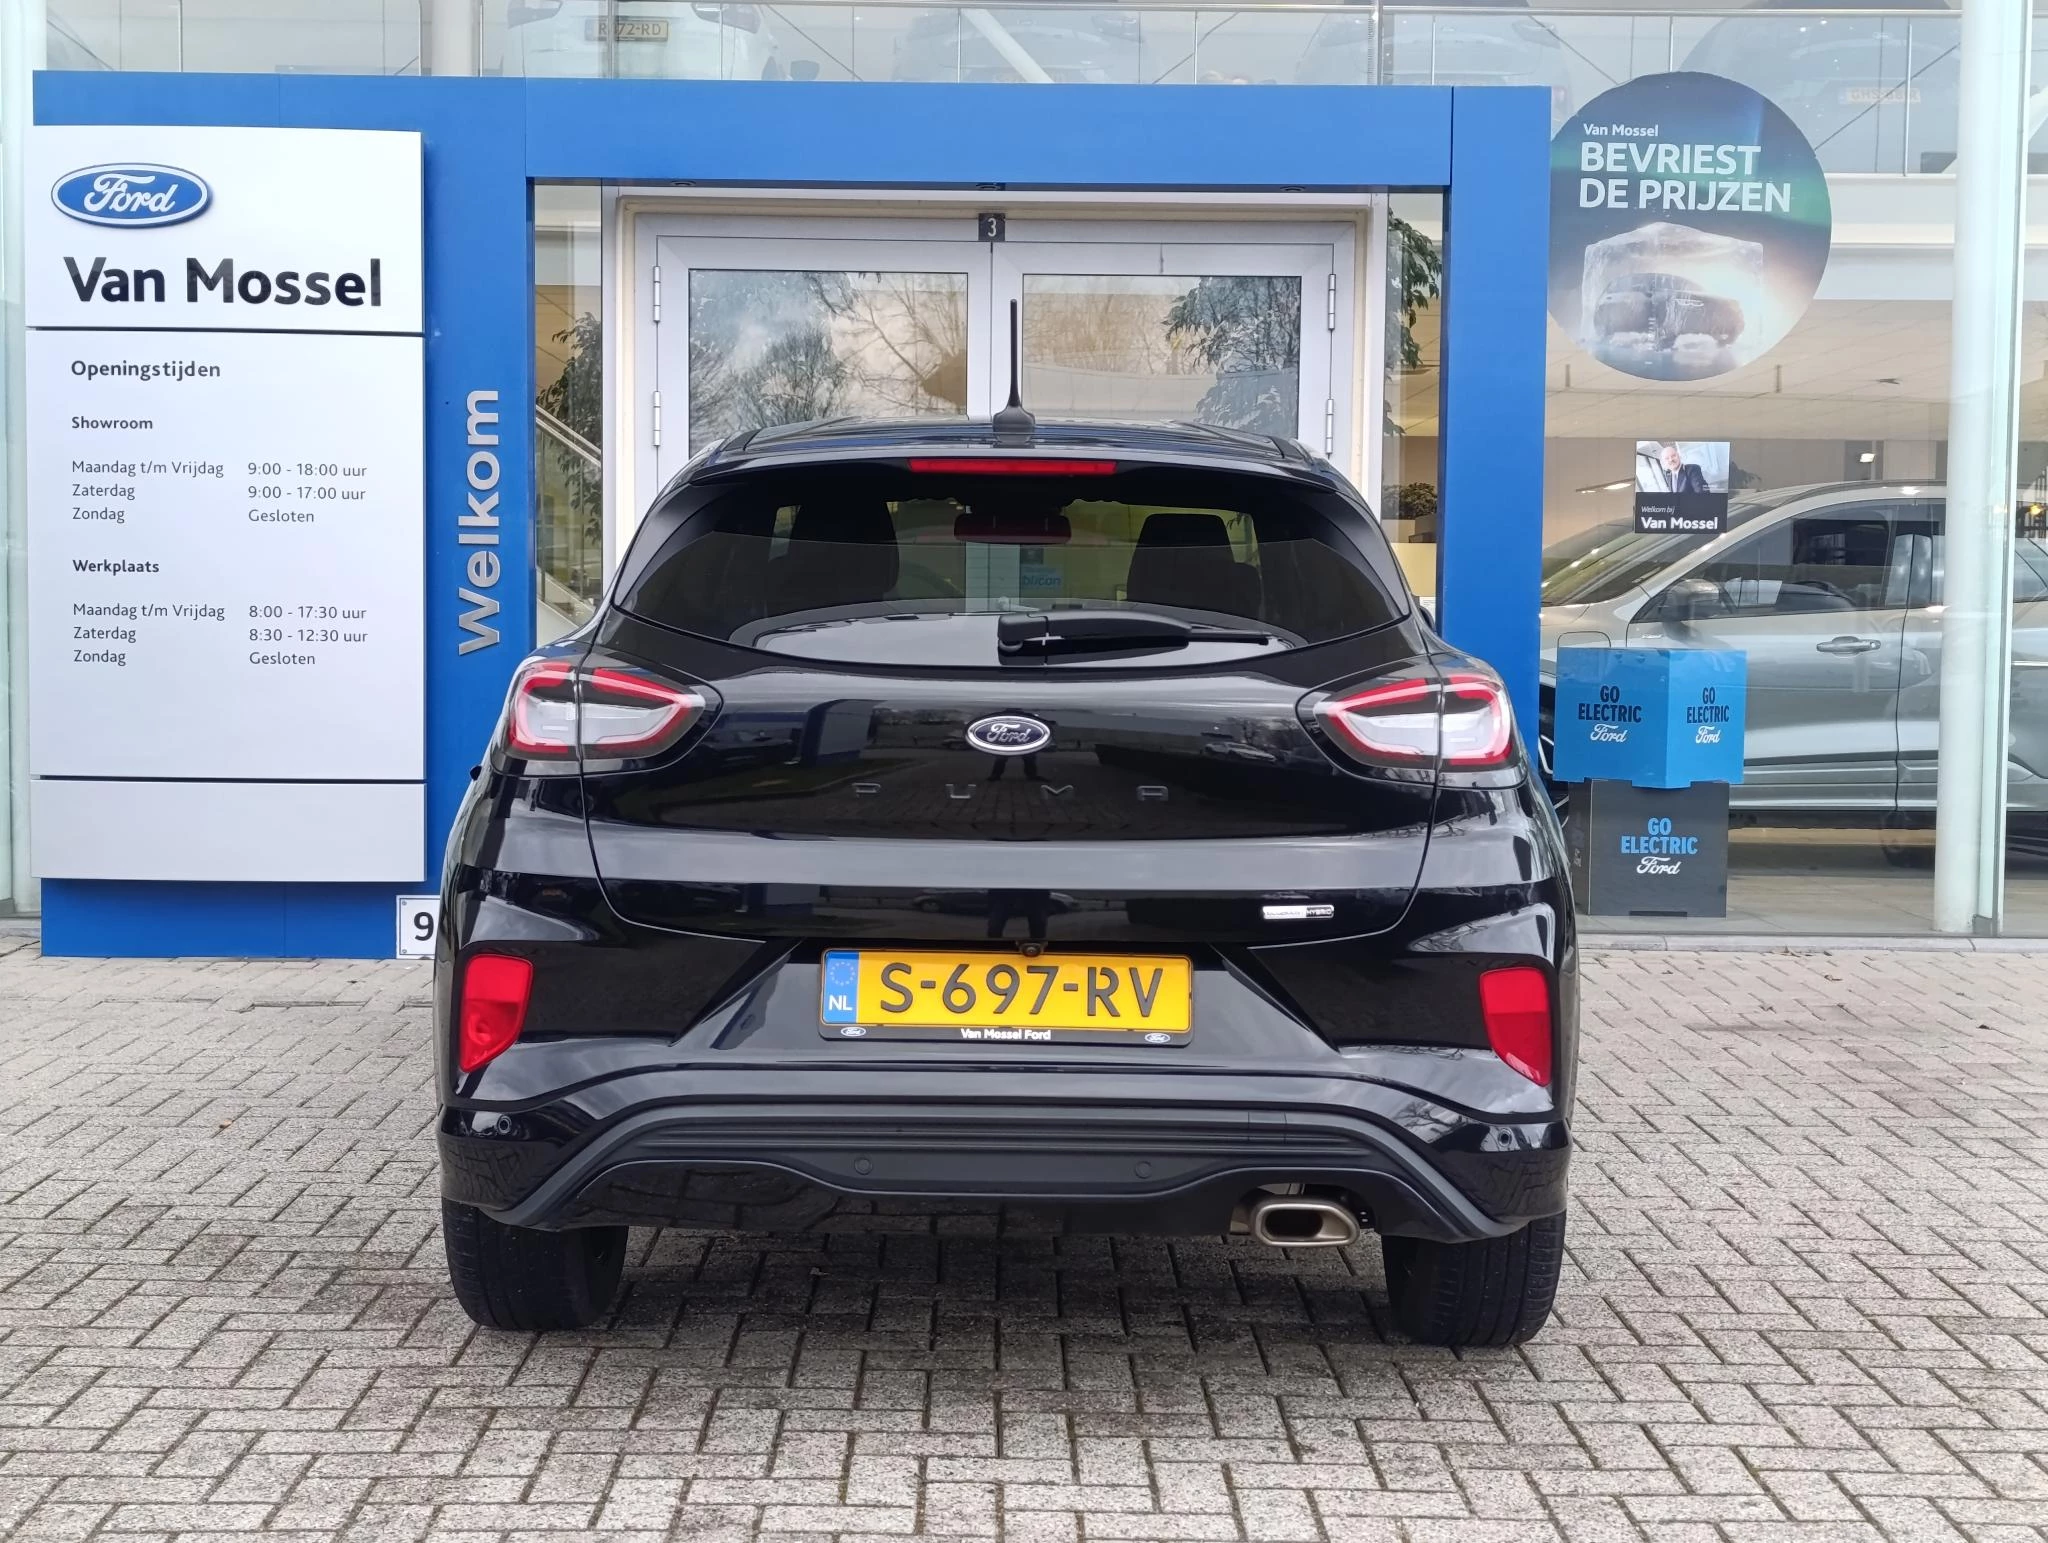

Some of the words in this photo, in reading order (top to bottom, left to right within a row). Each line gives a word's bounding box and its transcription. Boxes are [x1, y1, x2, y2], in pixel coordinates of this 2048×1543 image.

[1583, 123, 1608, 136] Van
[1612, 124, 1659, 136] Mossel
[1580, 141, 1761, 175] BEVRIEST
[83, 174, 178, 214] Ford
[1579, 178, 1629, 208] DE
[1638, 180, 1791, 212] PRIJZEN
[988, 218, 996, 236] 3
[63, 256, 166, 303] Van
[186, 257, 382, 307] Mossel
[71, 360, 221, 381] Openingstijden
[71, 415, 153, 430] Showroom
[71, 460, 136, 478] Maandag
[140, 460, 168, 475] t/m
[171, 460, 225, 478] Vrijdag
[247, 462, 282, 477] 9:00
[296, 462, 338, 478] 18:00
[342, 465, 368, 478] uur
[71, 483, 136, 501] Zaterdag
[247, 485, 282, 500] 9:00
[296, 485, 337, 501] 17:00
[341, 488, 367, 501] uur
[71, 506, 126, 524] Zondag
[248, 508, 315, 524] Gesloten
[458, 390, 500, 656] Welkom
[1641, 516, 1666, 529] Van
[1670, 516, 1718, 530] Mossel
[72, 559, 160, 576] Werkplaats
[72, 603, 137, 621] Maandag
[141, 603, 168, 618] t/m
[172, 603, 226, 621] Vrijdag
[248, 605, 283, 619] 8:00
[298, 605, 338, 620] 17:30
[342, 607, 367, 620] uur
[72, 626, 137, 643] Zaterdag
[248, 628, 283, 643] 8:30
[298, 628, 339, 643] 12:30
[343, 631, 368, 643] uur
[73, 649, 127, 667] Zondag
[249, 651, 316, 666] Gesloten
[1600, 686, 1620, 703] GO
[1702, 687, 1716, 704] GO
[1578, 703, 1642, 723] ELECTRIC
[1686, 705, 1730, 724] ELECTRIC
[986, 723, 1031, 742] Ford
[1590, 724, 1628, 743] Ford
[1696, 726, 1720, 744] Ford
[1648, 817, 1672, 836] GO
[1621, 836, 1698, 854] ELECTRIC
[1636, 856, 1682, 875] Ford
[414, 912, 434, 942] 9
[828, 995, 852, 1010] NL
[880, 962, 1163, 1017] S-697-RV
[960, 1028, 981, 1038] Van
[984, 1029, 1022, 1040] Mossel
[1024, 1030, 1052, 1040] Ford
